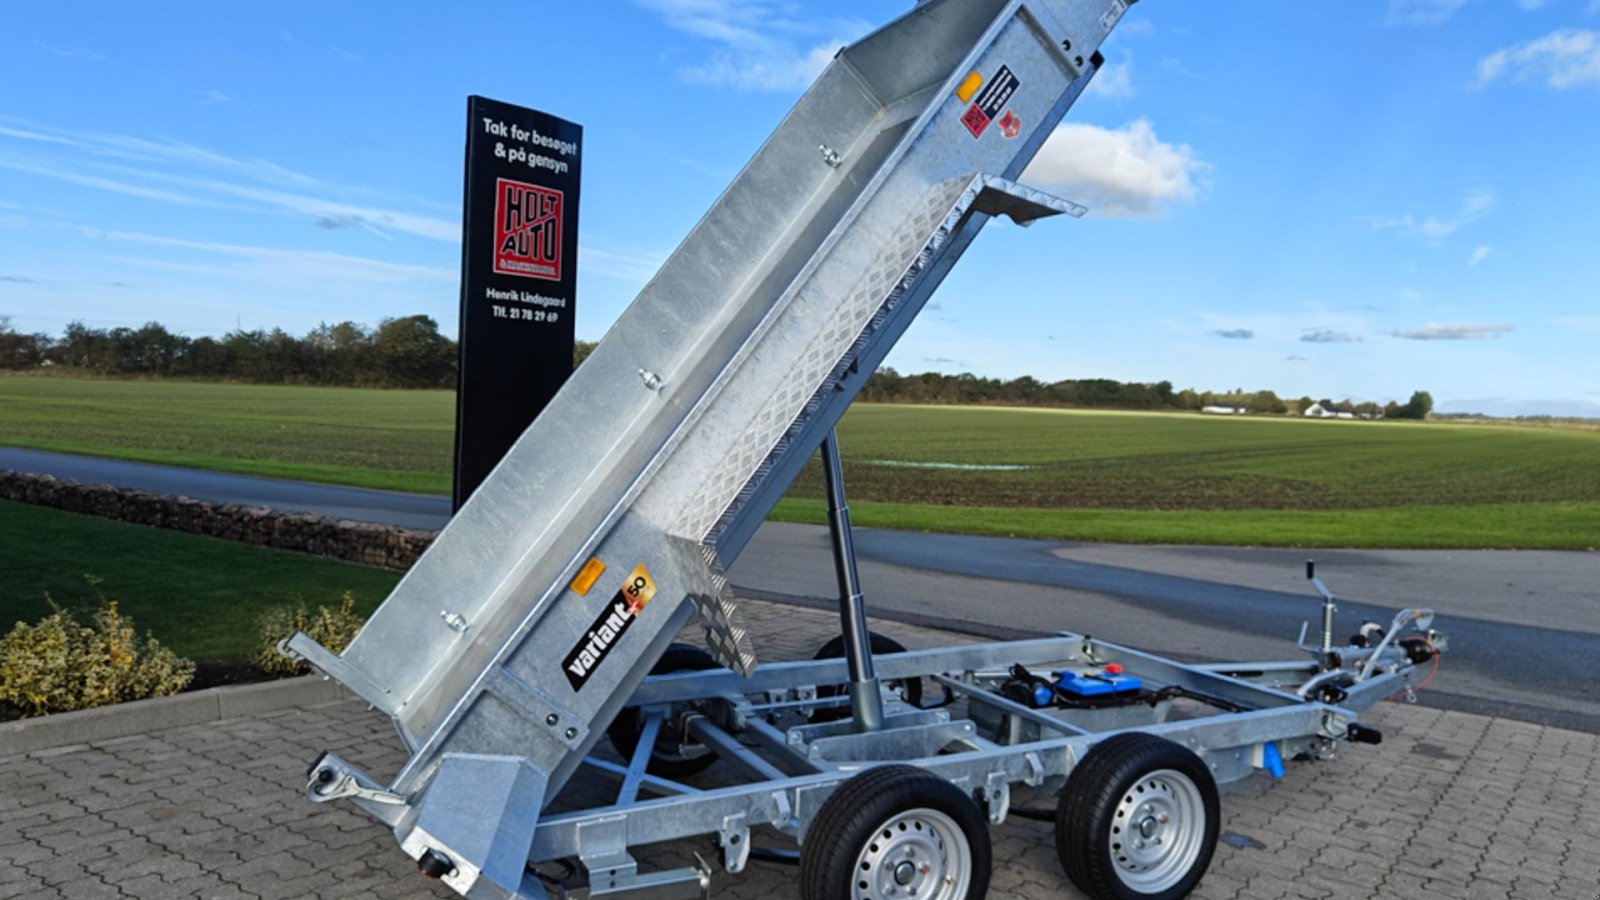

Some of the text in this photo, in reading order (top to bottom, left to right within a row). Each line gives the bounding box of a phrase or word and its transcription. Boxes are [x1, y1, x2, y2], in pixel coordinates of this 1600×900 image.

[483, 118, 577, 156] Tak for besøget
[494, 142, 568, 174] & på gensyn
[504, 184, 558, 232] HOLT
[501, 215, 557, 262] AUTO
[486, 287, 519, 301] Henrik
[510, 307, 520, 319] 21
[521, 308, 533, 320] 78
[534, 310, 546, 321] 29
[568, 576, 647, 677] variant 50
